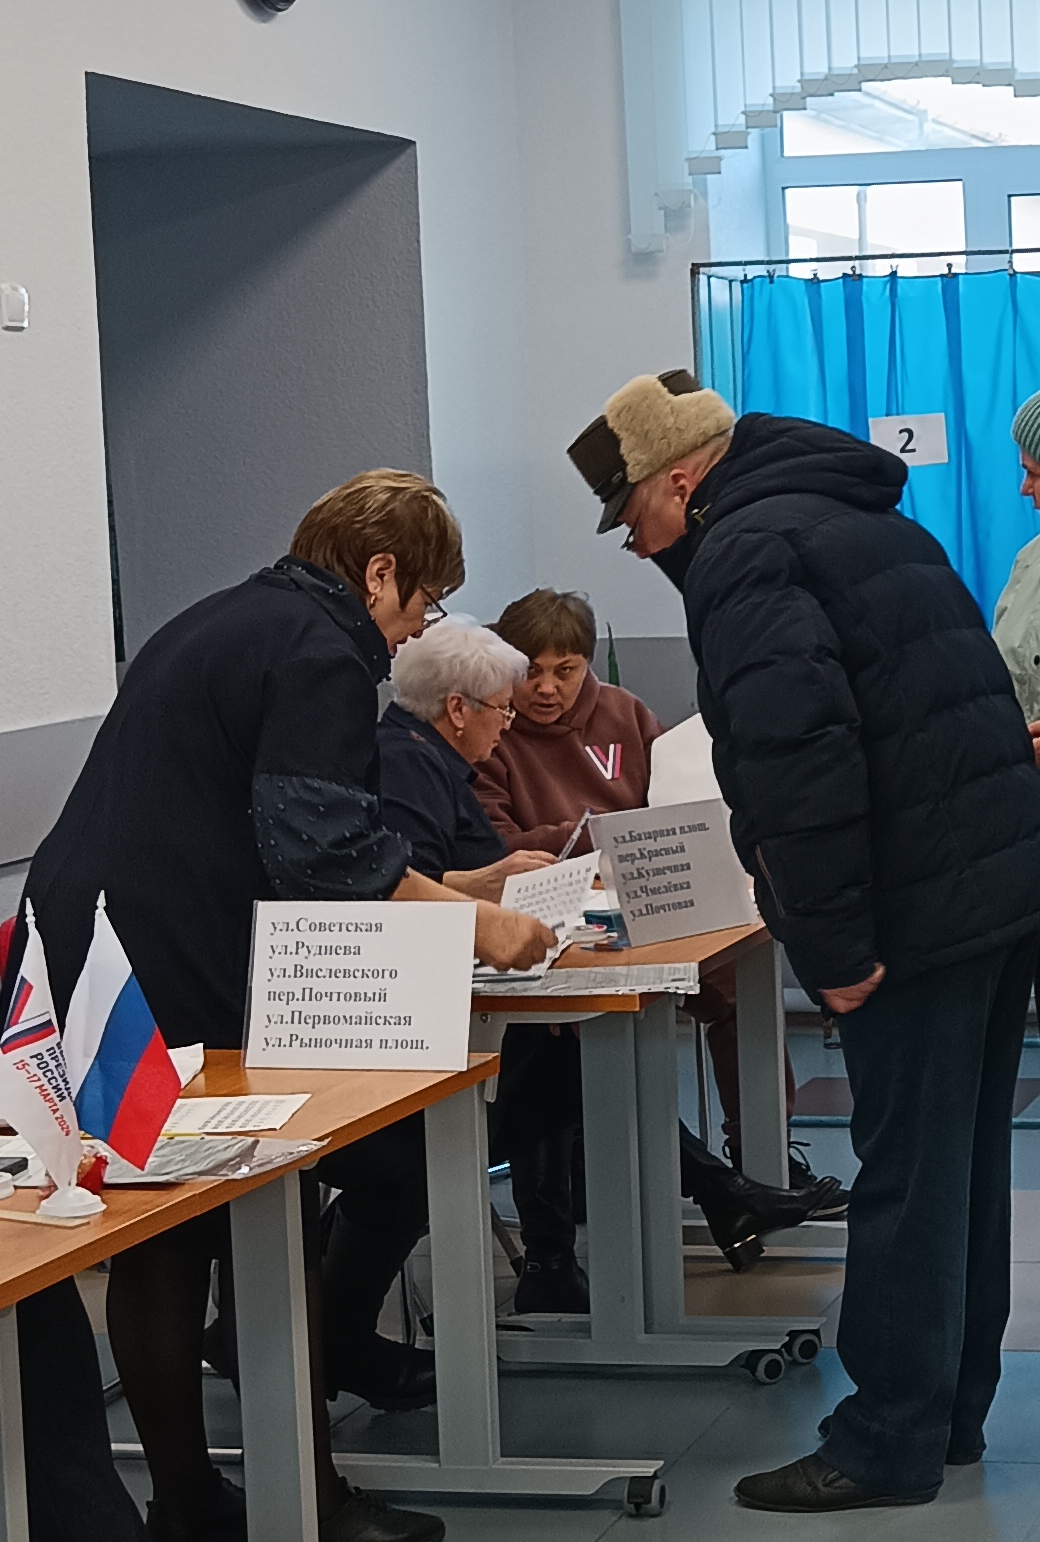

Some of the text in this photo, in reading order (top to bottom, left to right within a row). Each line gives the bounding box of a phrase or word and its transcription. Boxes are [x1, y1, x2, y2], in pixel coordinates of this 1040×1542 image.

[898, 428, 916, 455] 2
[270, 917, 383, 936] ул.Советская
[268, 941, 362, 959] ул.Руднева
[267, 964, 398, 982] ул.Вислевского
[267, 987, 387, 1005] пер.Почтовый
[264, 1010, 412, 1029] ул.Первомайская
[262, 1034, 430, 1051] ул.Рыночная площ.
[30, 1052, 67, 1103] РОССИИ
[34, 1084, 60, 1115] МАРТА
[54, 1114, 71, 1137] 2024
